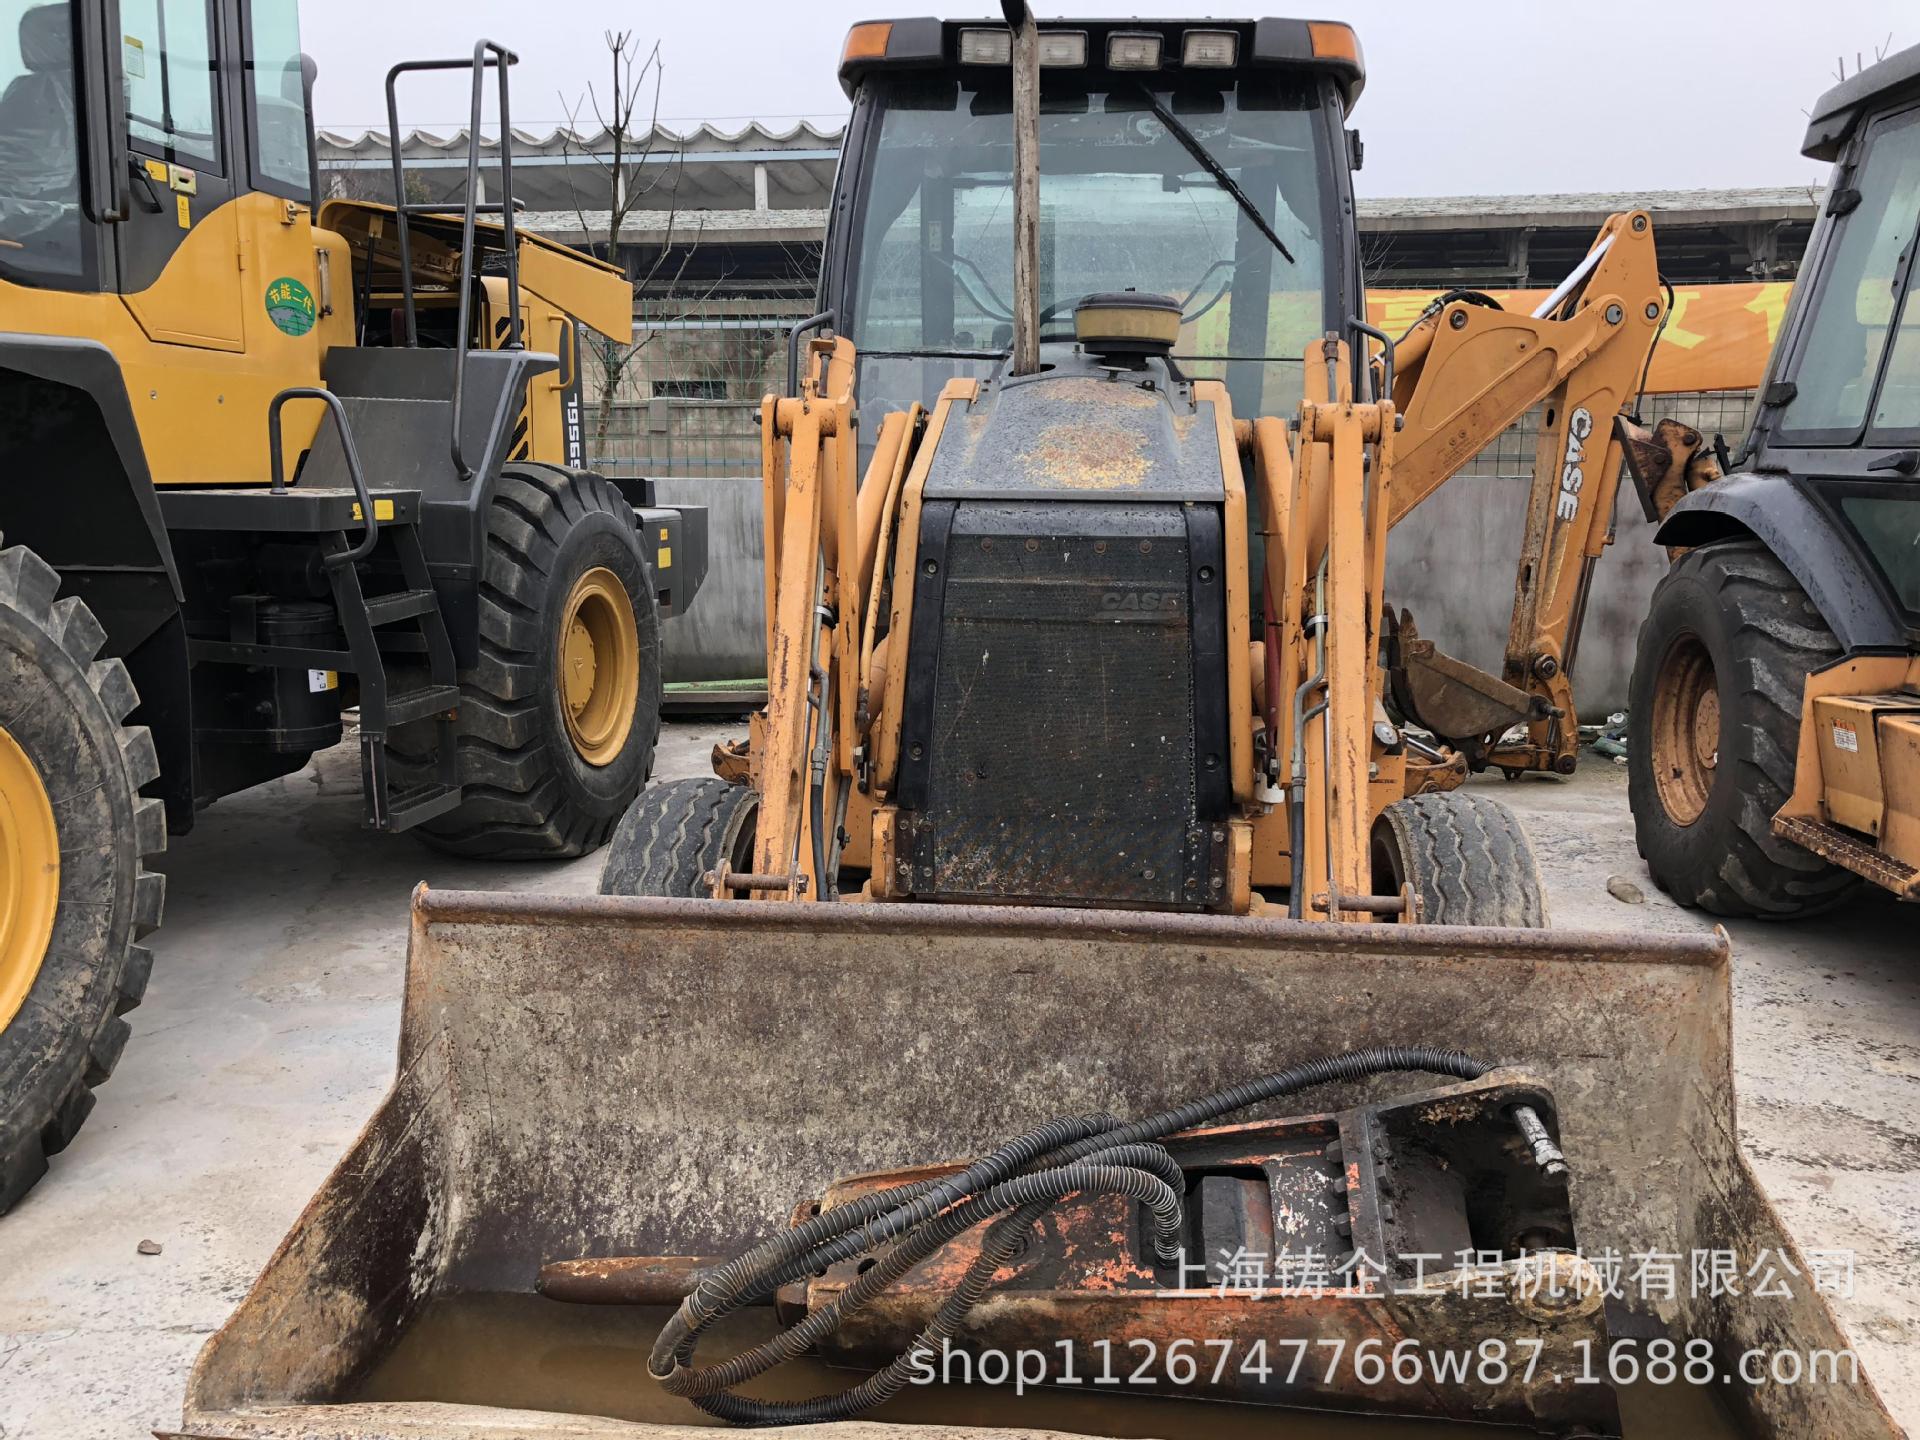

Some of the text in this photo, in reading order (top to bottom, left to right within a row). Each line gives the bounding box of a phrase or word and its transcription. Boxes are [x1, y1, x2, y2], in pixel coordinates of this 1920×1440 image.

[268, 282, 313, 315] 节能二代
[1556, 406, 1593, 523] CASE
[1101, 592, 1181, 610] CASE
